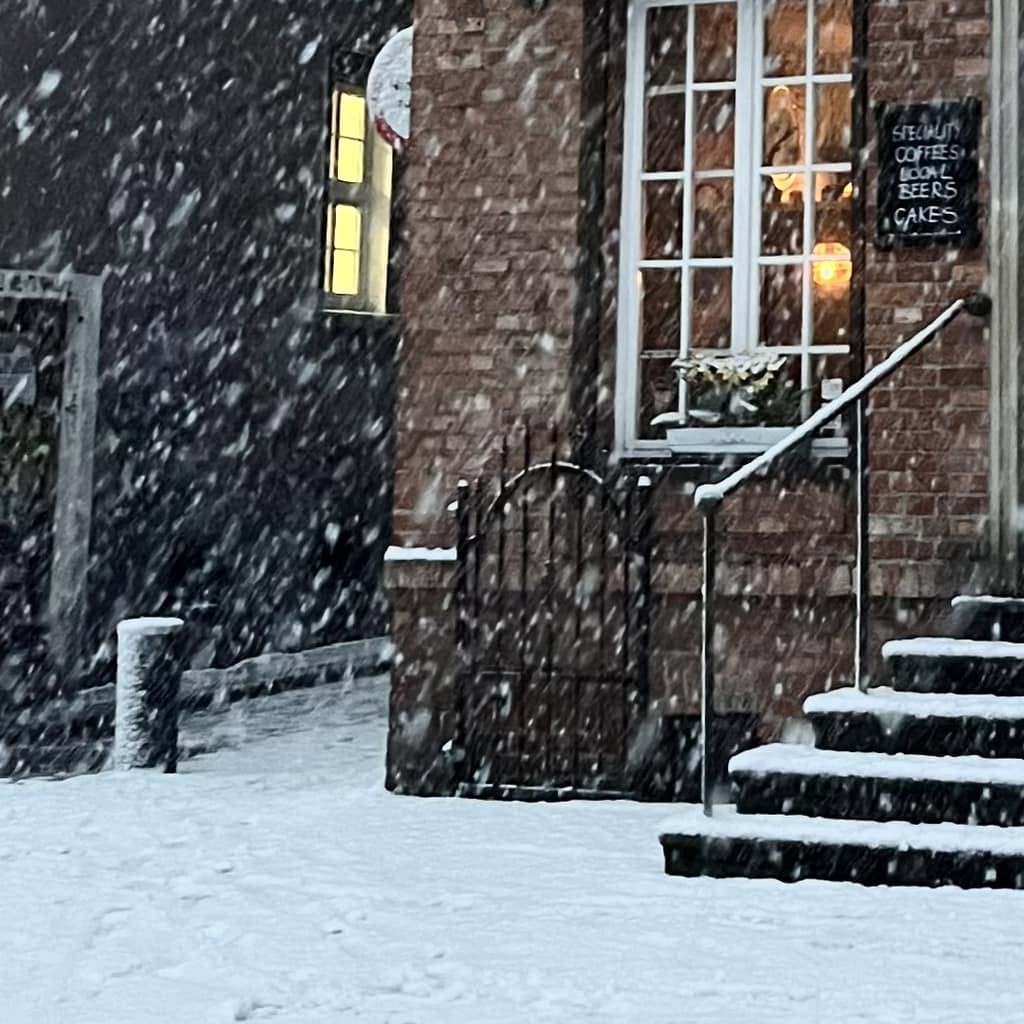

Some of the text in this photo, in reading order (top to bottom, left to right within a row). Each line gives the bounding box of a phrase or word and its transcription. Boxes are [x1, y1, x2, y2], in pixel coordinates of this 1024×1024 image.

[896, 145, 960, 164] COFFEES
[899, 181, 958, 200] BEERS
[894, 206, 959, 231] CAKES
